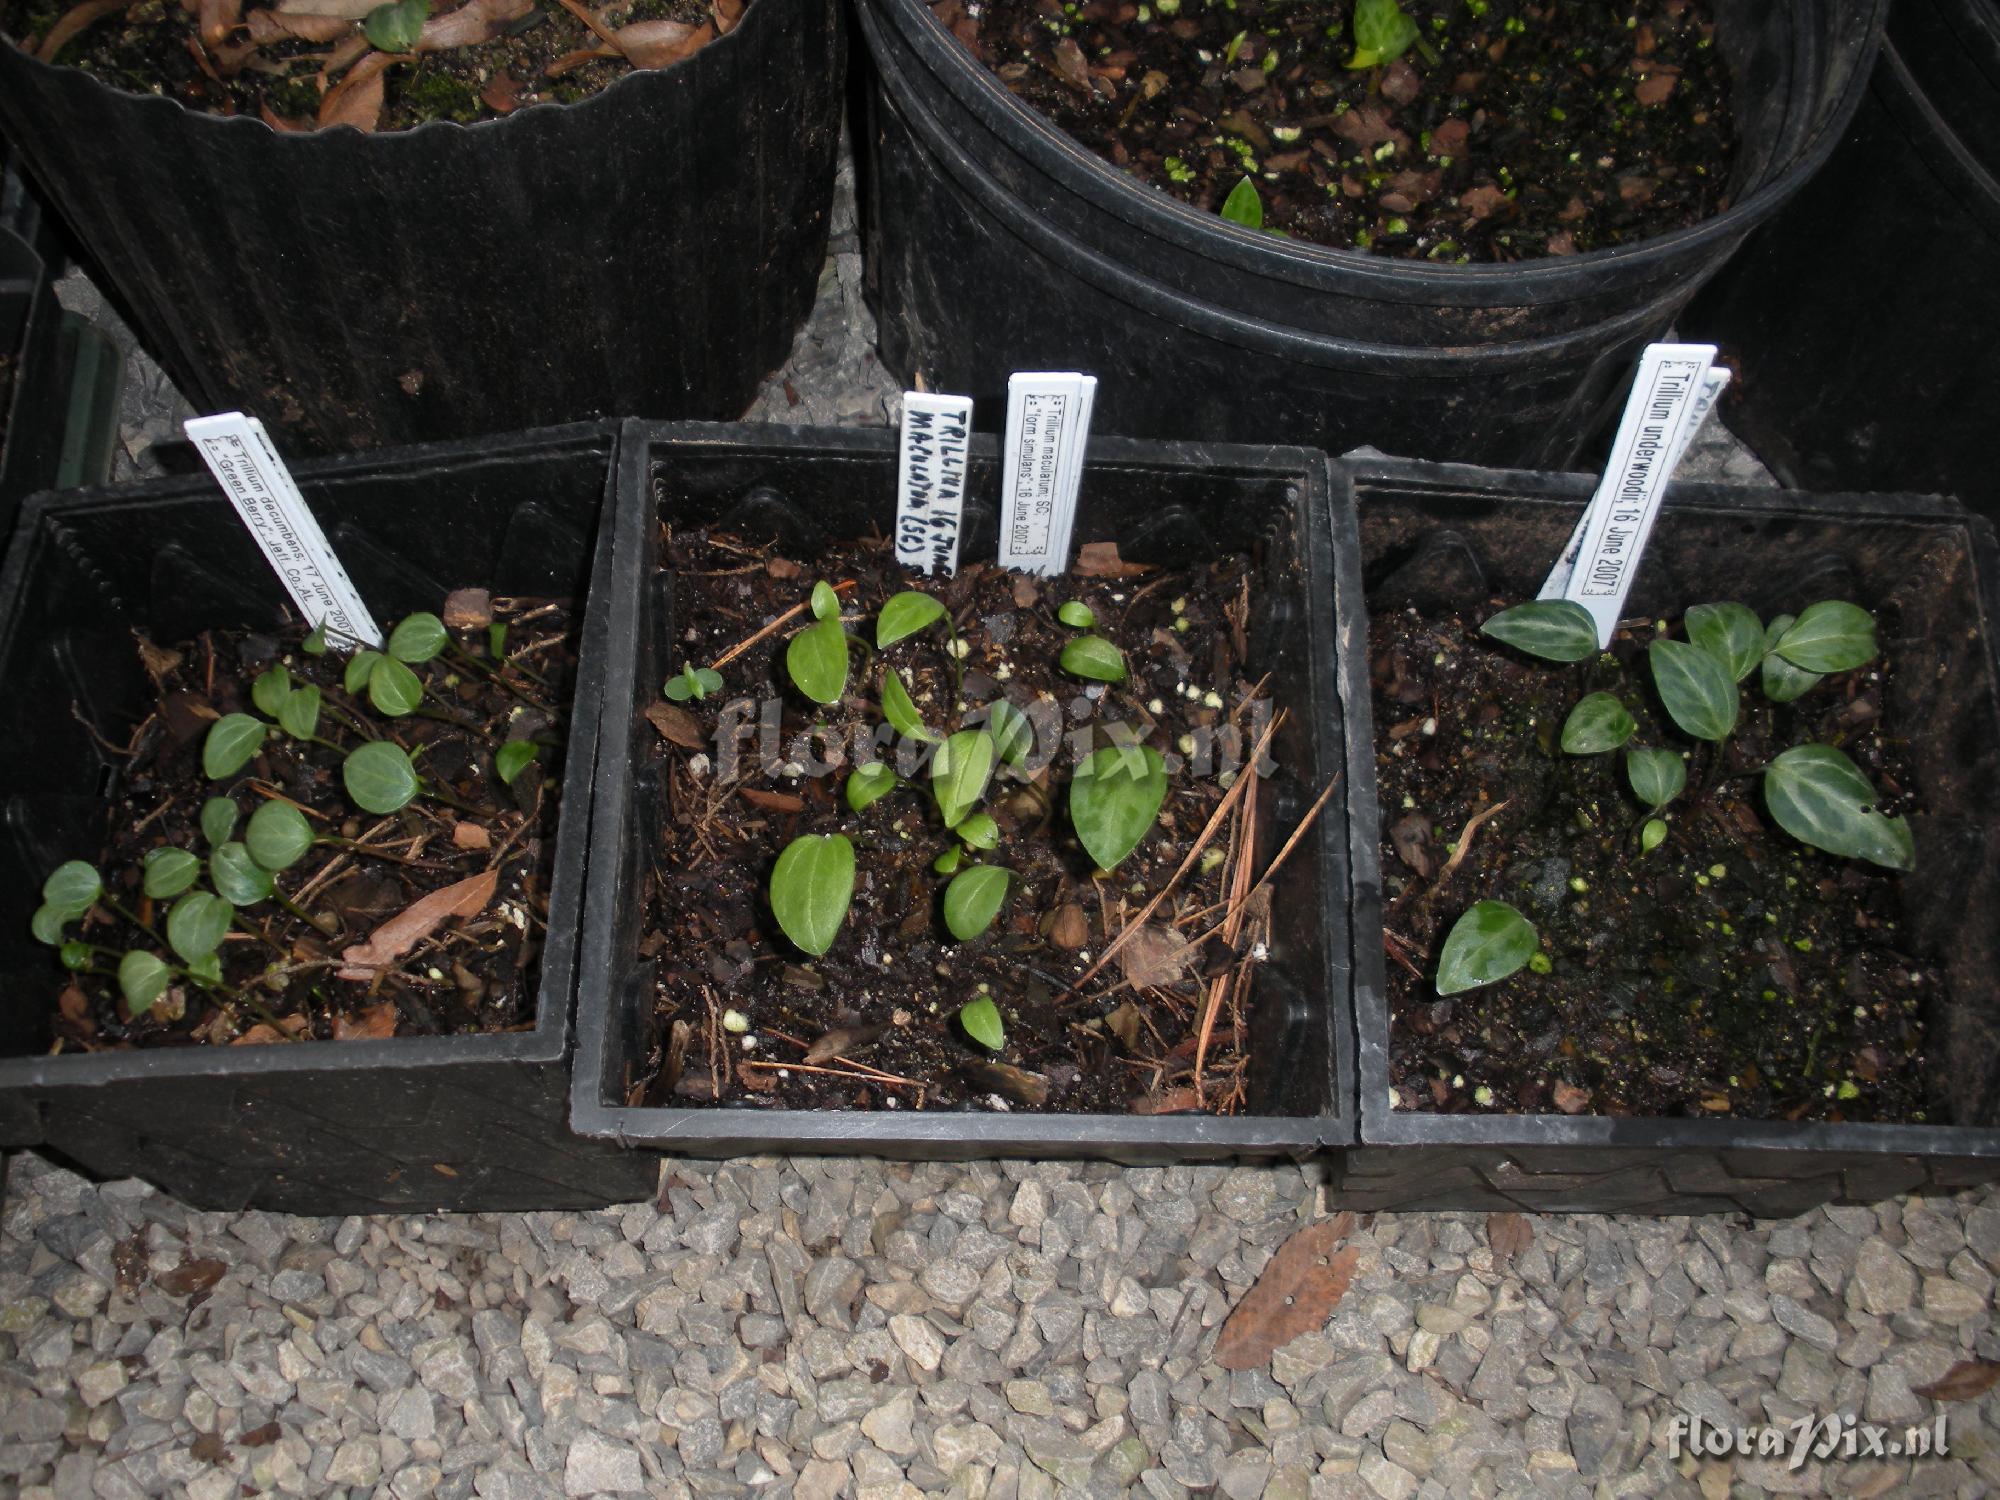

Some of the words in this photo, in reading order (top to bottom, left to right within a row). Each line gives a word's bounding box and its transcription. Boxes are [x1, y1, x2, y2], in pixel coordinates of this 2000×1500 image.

[1649, 373, 1690, 420] Trillium
[1044, 408, 1062, 443] Trillium
[1614, 426, 1664, 504] underwoodii;
[1018, 488, 1033, 498] 16
[929, 510, 958, 530] 16
[1016, 501, 1031, 522] June
[1613, 509, 1640, 522] 16
[234, 451, 263, 493] Trillium
[303, 565, 319, 577] 17
[312, 581, 333, 606] June
[329, 609, 353, 634] 2007
[897, 515, 930, 553] (SC)
[1014, 524, 1030, 544] 2007
[1600, 527, 1629, 555] June
[1592, 559, 1623, 587] 2007
